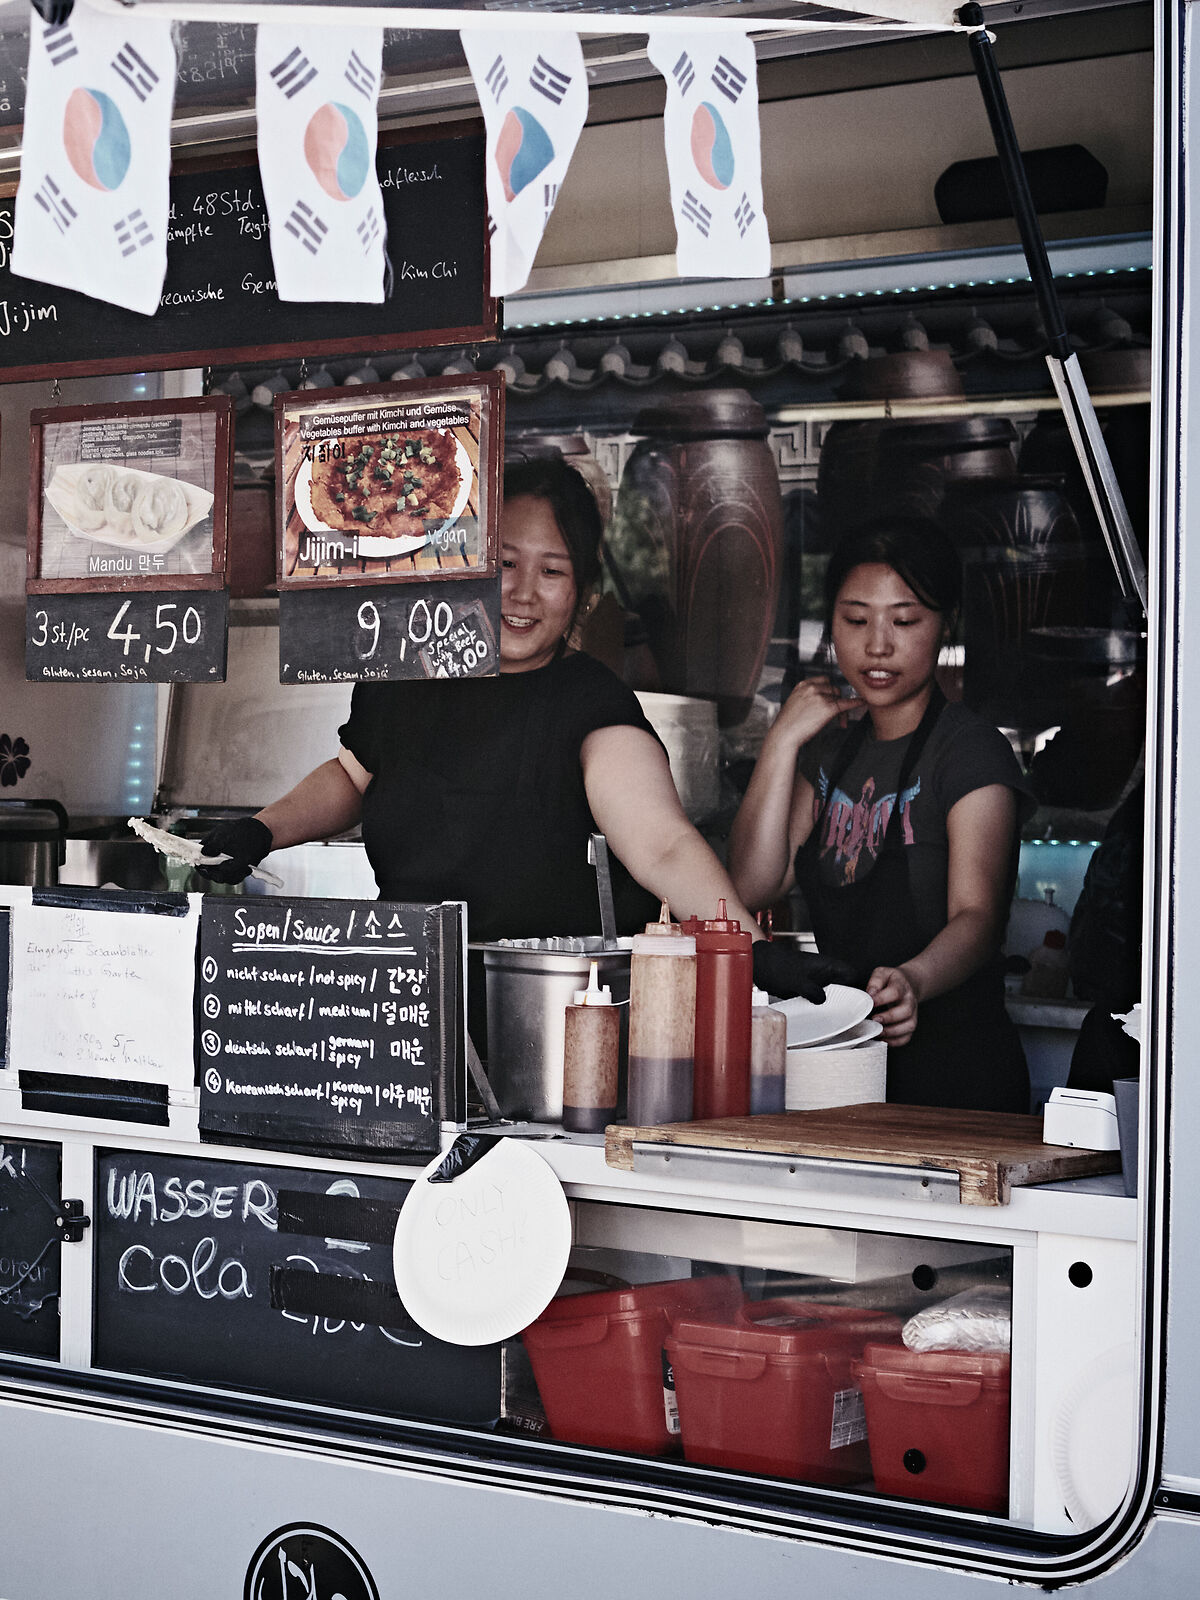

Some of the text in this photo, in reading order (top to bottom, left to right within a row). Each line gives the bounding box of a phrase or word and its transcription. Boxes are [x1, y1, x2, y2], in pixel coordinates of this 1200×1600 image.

[167, 222, 214, 245] ämpfte
[158, 283, 225, 307] reanische
[240, 272, 279, 294] Gem
[300, 414, 470, 441] Vegetables buffer with Kimchi and vegetables
[312, 403, 458, 427] Gemüsepuffer mit Kimchi und Gemüse
[89, 553, 165, 572] Mandu 만두
[299, 535, 359, 567] Jijim-i
[106, 599, 201, 664] 4,50
[357, 599, 454, 662] 9,00
[120, 664, 148, 680] Soja
[361, 910, 407, 939] 소스
[386, 966, 427, 996] 간장
[390, 1037, 426, 1066] 매운
[107, 1167, 279, 1233] WASSER
